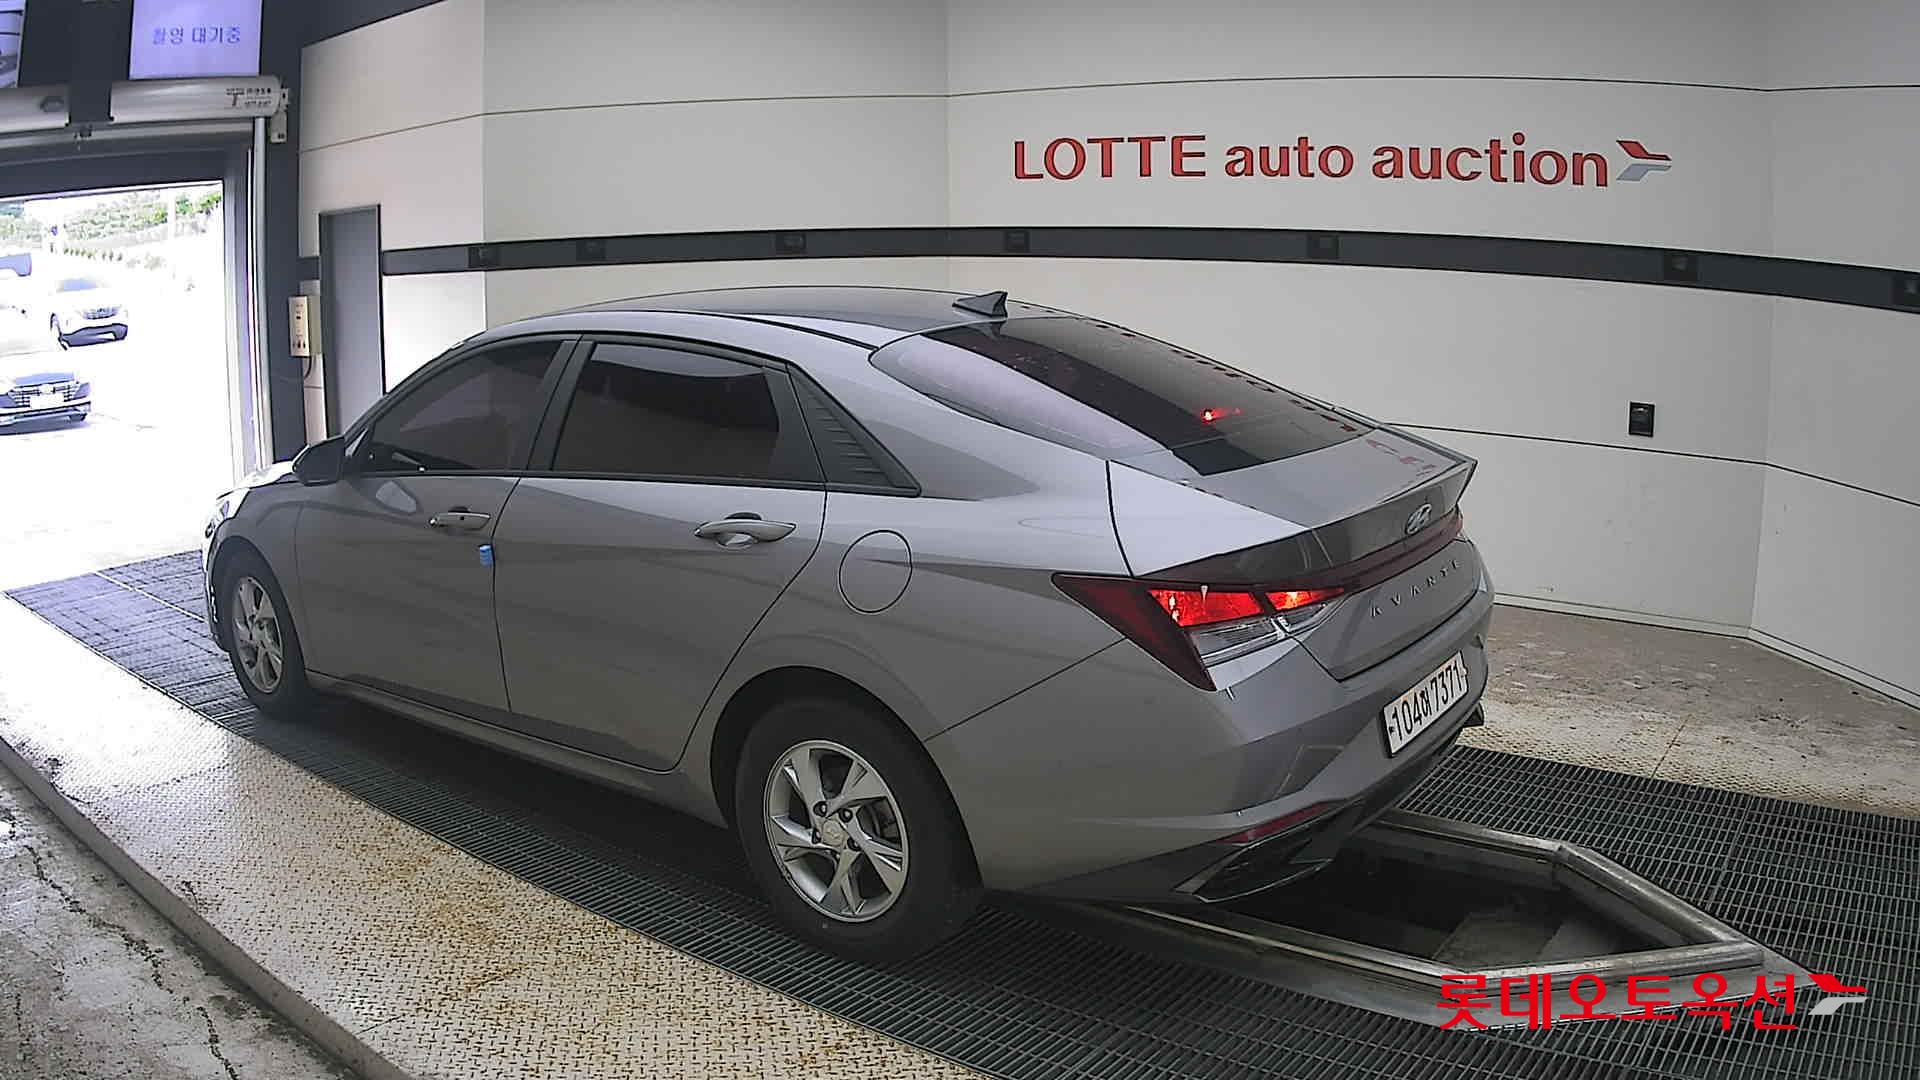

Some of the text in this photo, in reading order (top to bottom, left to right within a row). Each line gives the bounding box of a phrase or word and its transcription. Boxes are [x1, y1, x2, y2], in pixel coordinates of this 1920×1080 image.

[192, 26, 241, 44] 대기중
[1013, 131, 1609, 188] LOTTE auto auction
